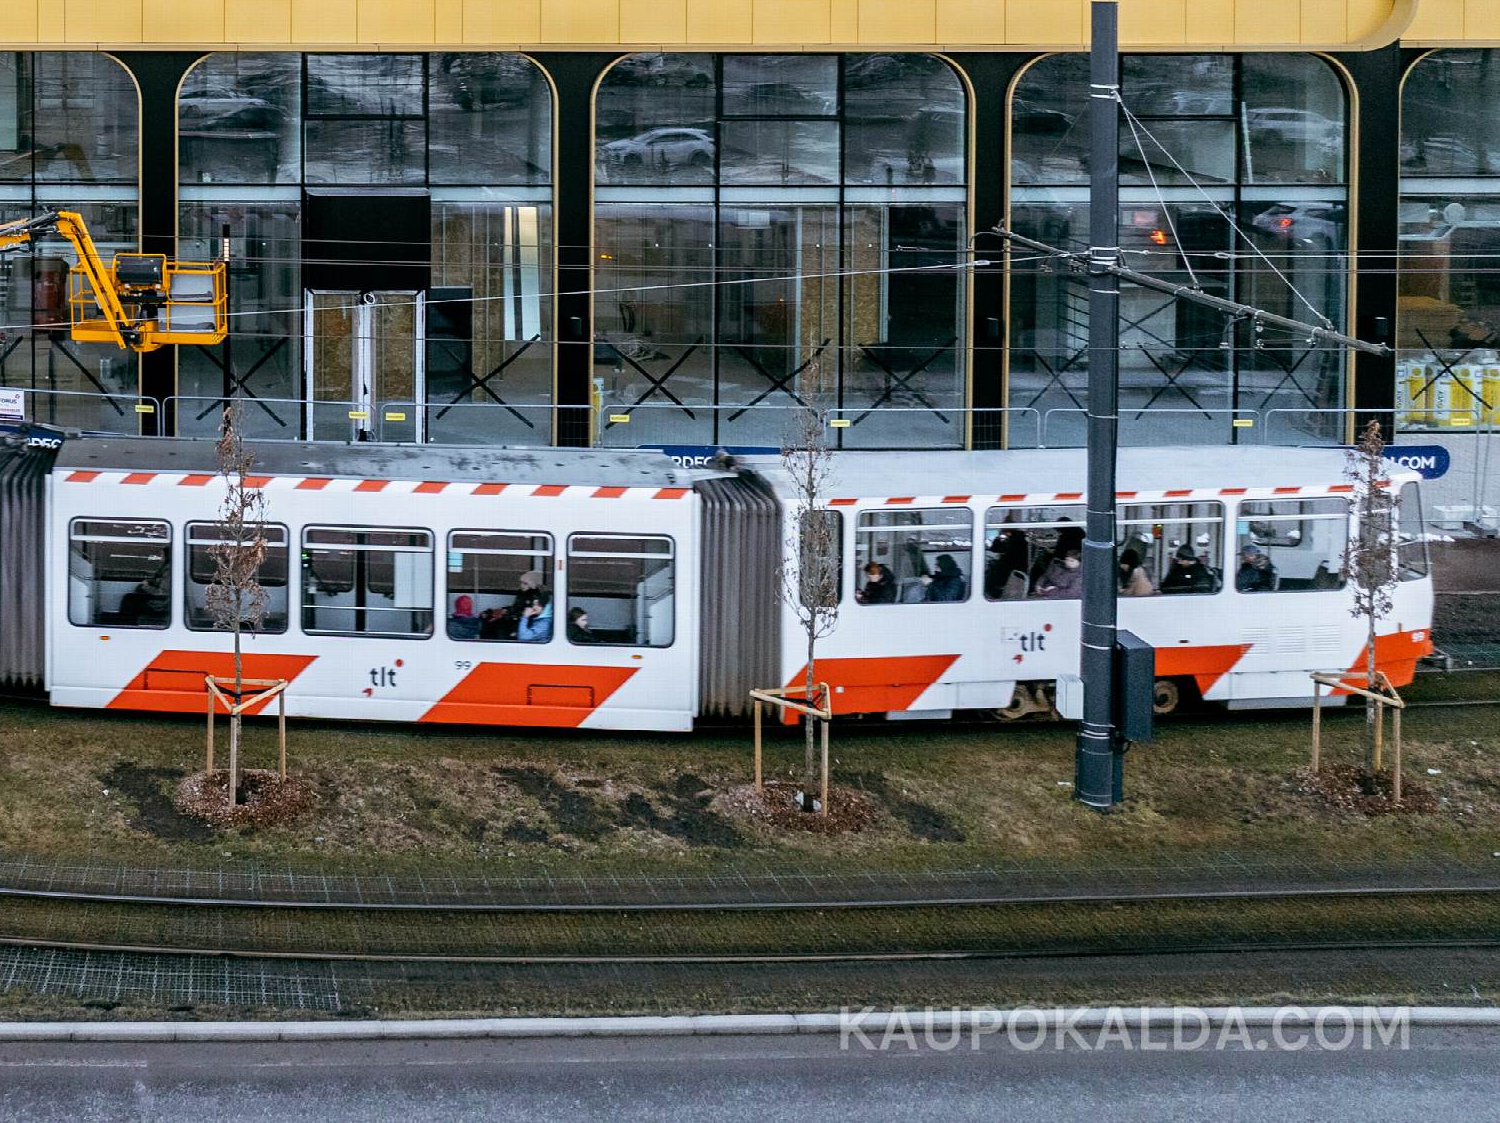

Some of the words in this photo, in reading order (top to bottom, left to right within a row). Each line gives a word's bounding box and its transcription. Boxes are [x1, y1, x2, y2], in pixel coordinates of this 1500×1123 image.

[1020, 631, 1046, 652] tlt
[454, 660, 472, 670] 99
[369, 666, 397, 687] tlt
